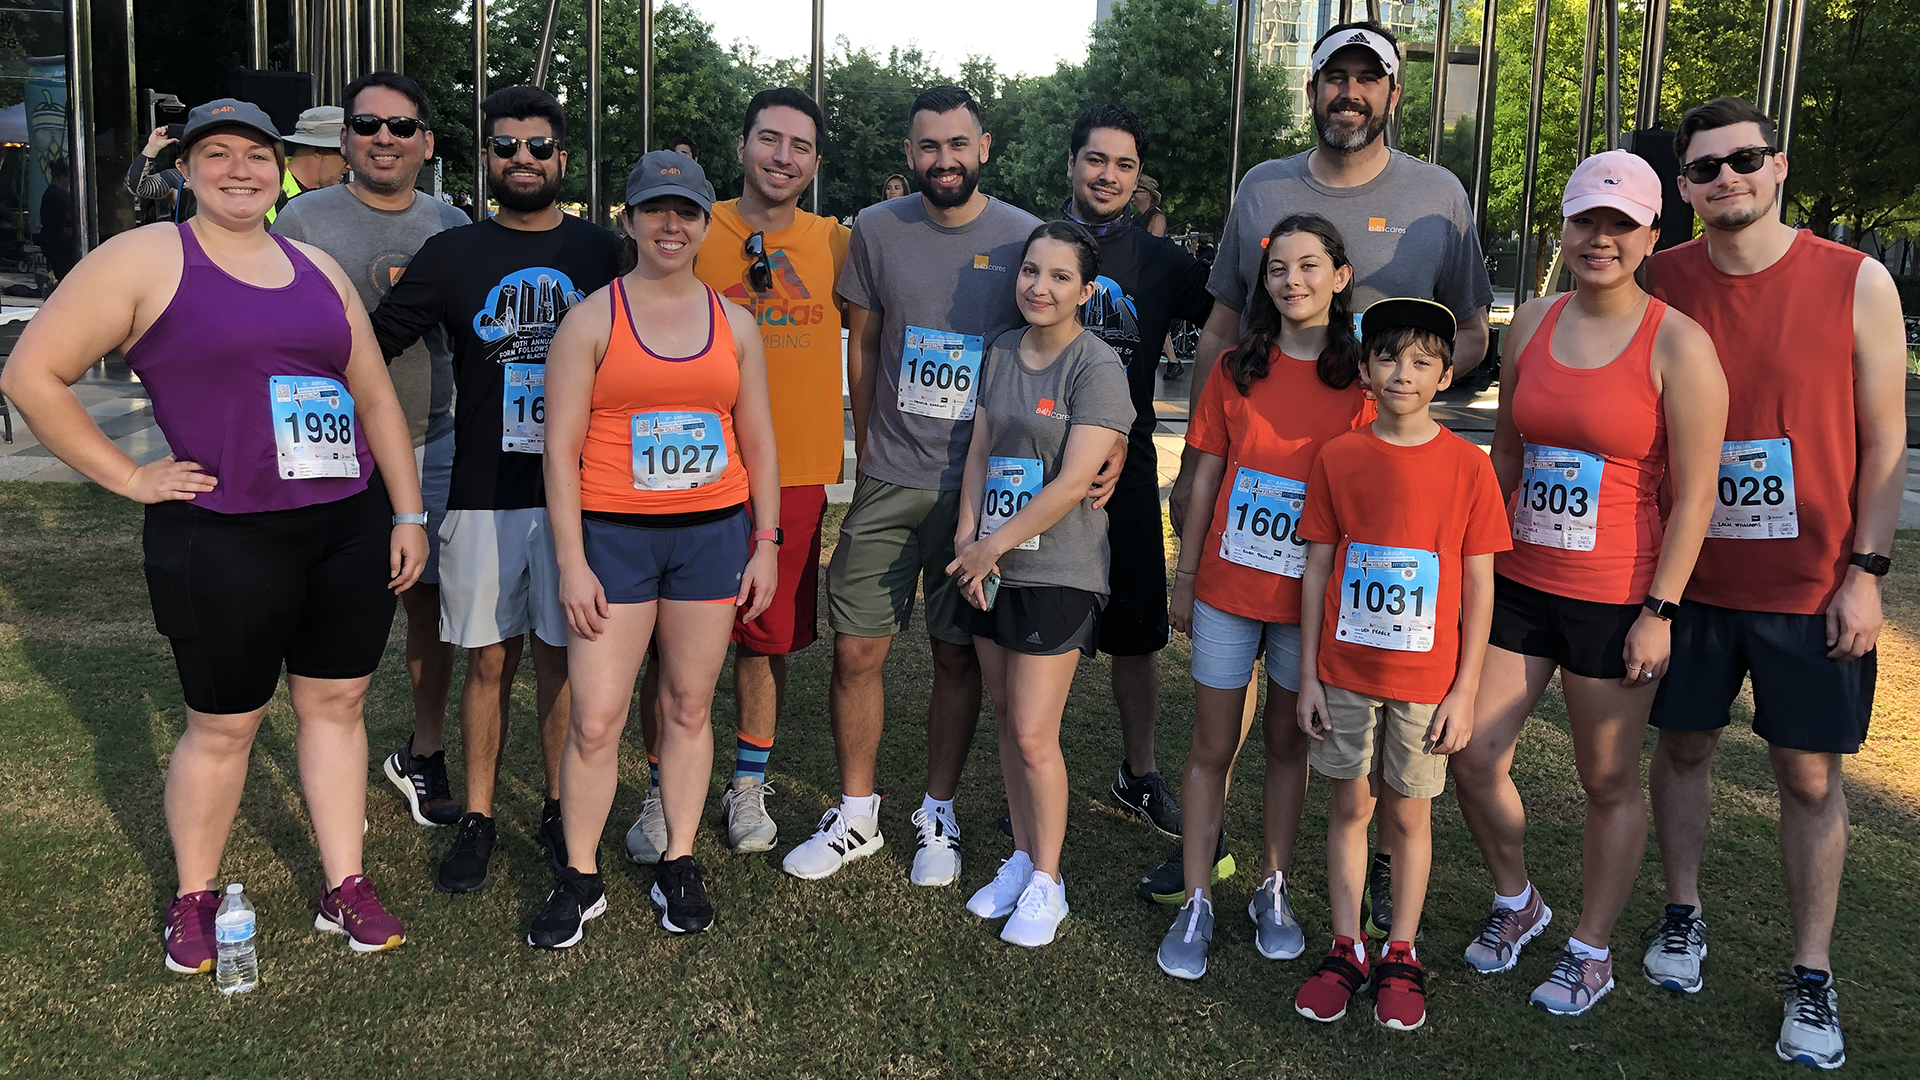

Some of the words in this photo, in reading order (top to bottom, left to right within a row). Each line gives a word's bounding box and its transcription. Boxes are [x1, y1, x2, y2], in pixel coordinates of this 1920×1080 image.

[500, 349, 516, 359] FORM
[512, 340, 528, 349] 10TH
[908, 358, 971, 392] 1606
[513, 395, 545, 424] 16
[284, 412, 351, 444] 1938
[642, 445, 719, 474] 1027
[986, 489, 1033, 518] 030
[1523, 479, 1588, 517] 1303
[1718, 475, 1784, 506] 028
[1349, 579, 1424, 617] 1031
